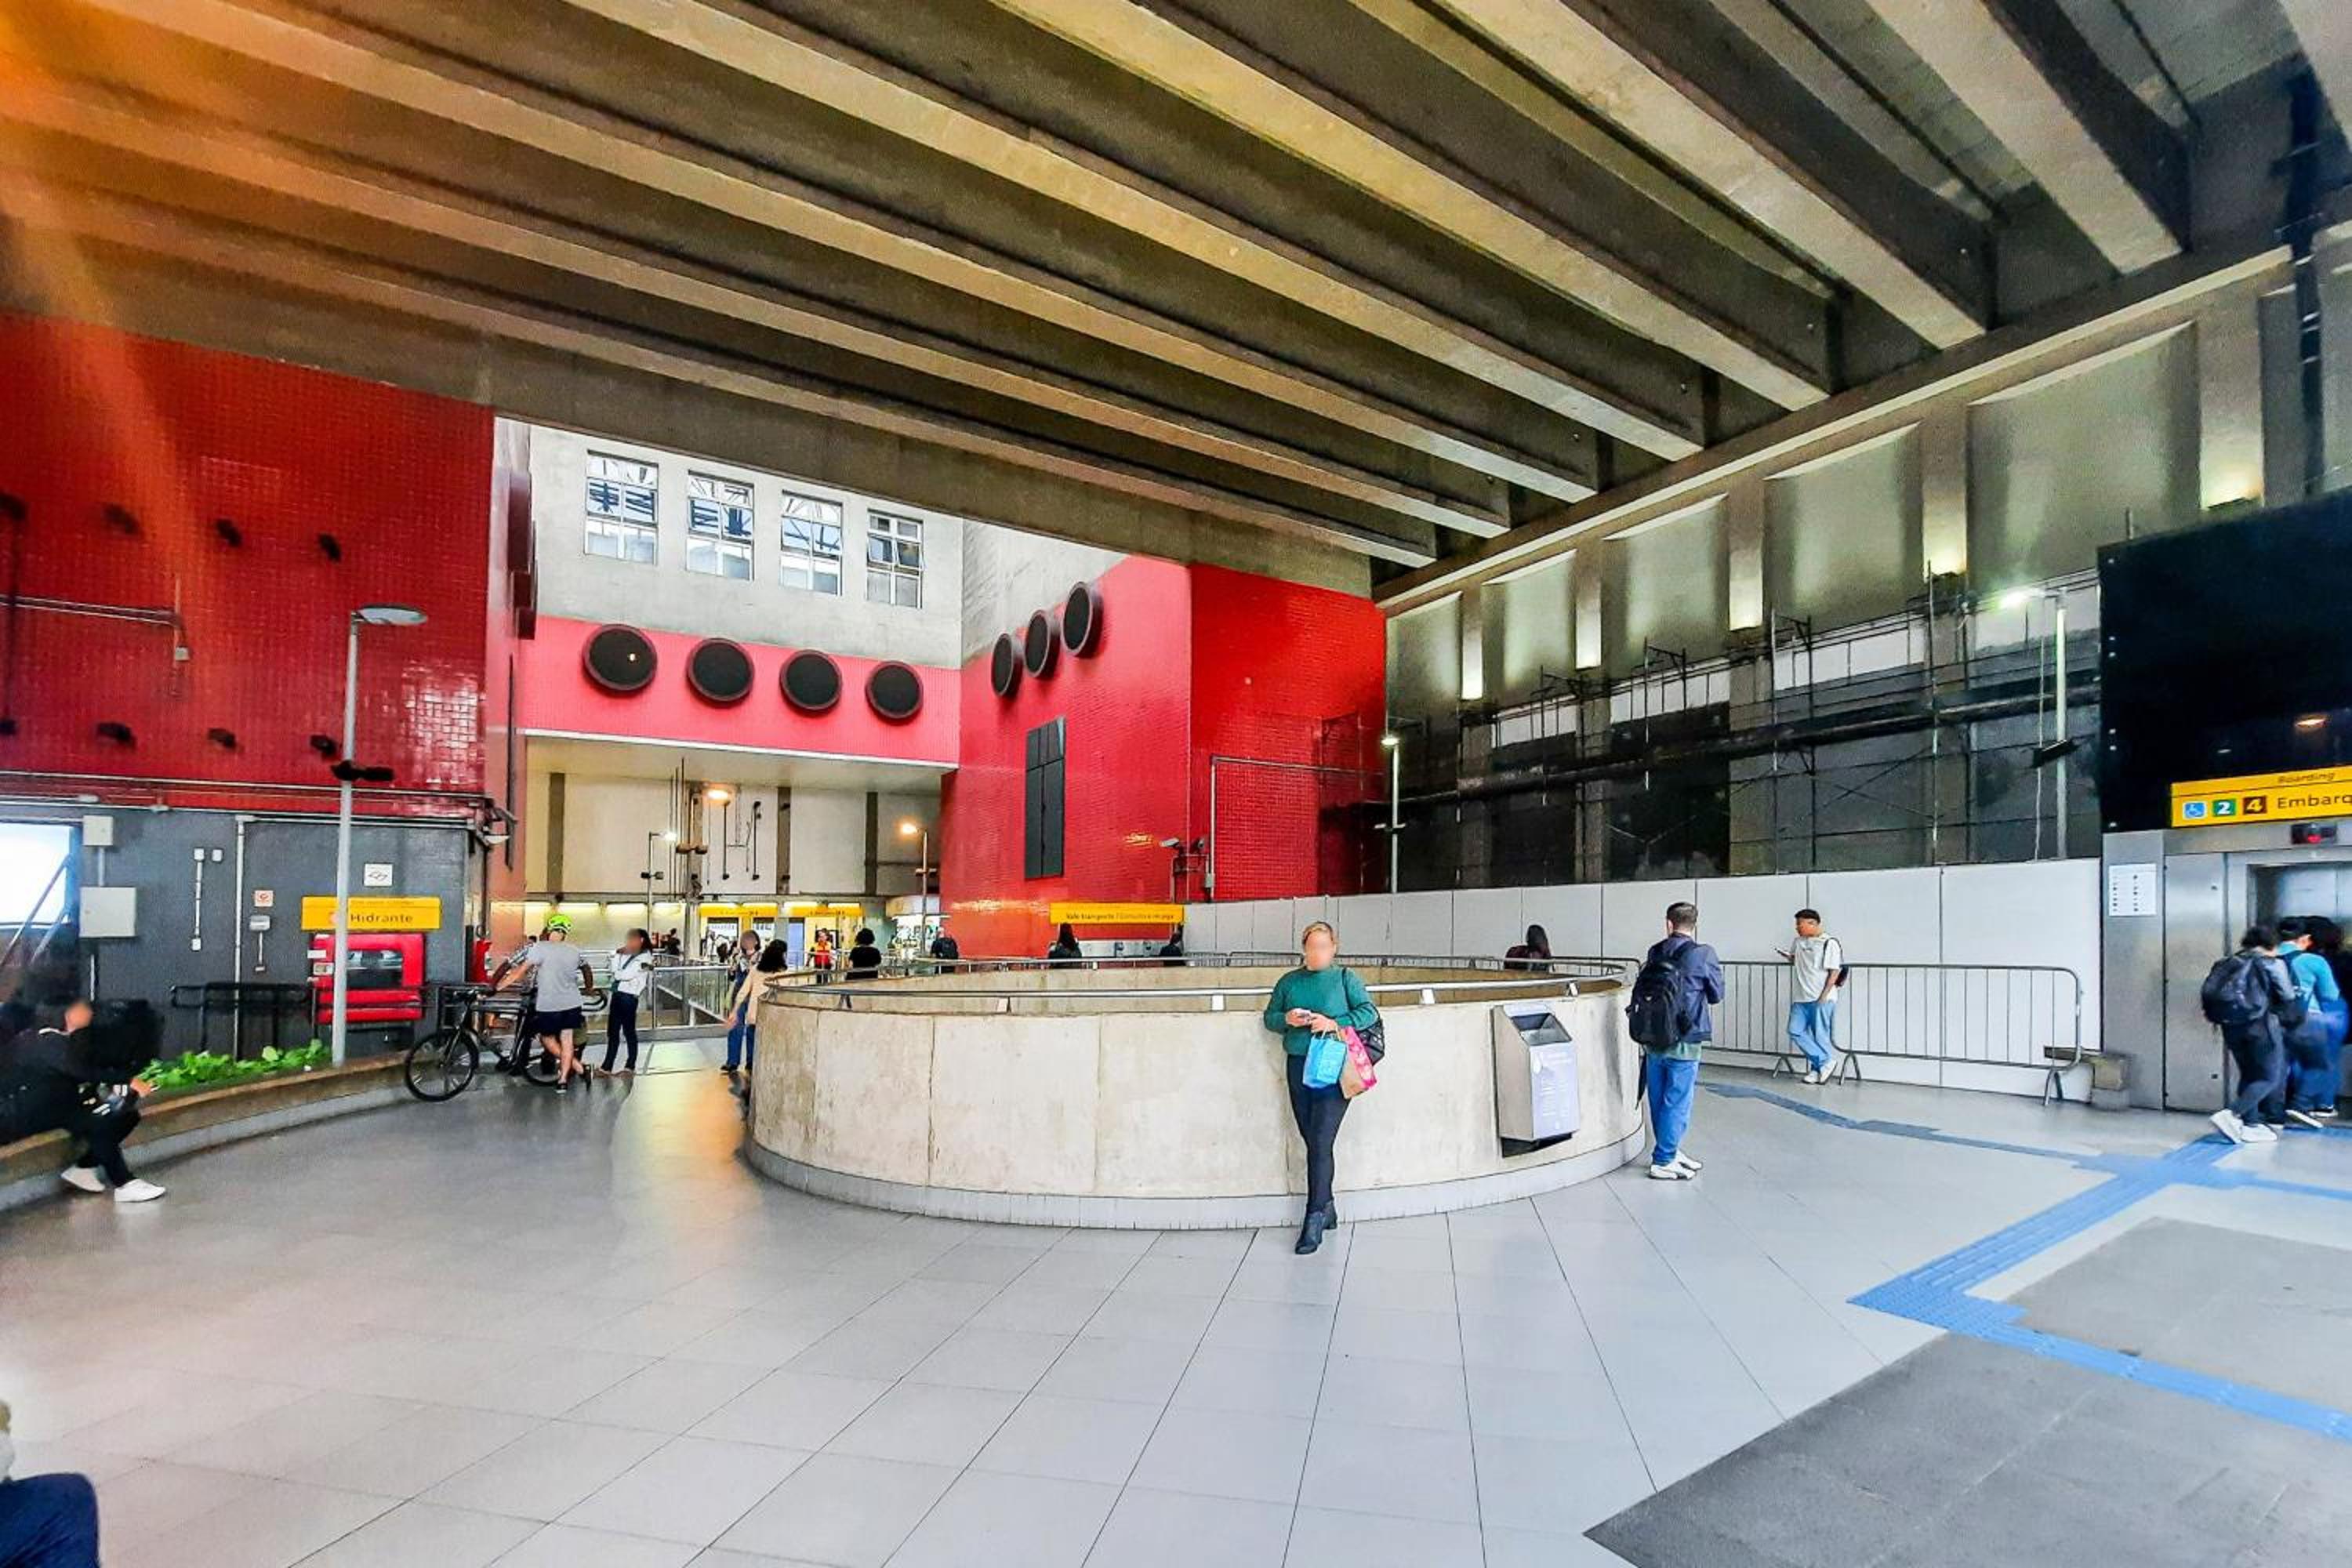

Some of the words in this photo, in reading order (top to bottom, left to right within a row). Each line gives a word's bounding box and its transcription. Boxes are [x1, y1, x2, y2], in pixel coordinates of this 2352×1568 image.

[2278, 772, 2335, 784] Boarding
[2216, 800, 2231, 815] 2
[2245, 798, 2263, 813] 4
[350, 913, 413, 924] Hidrante
